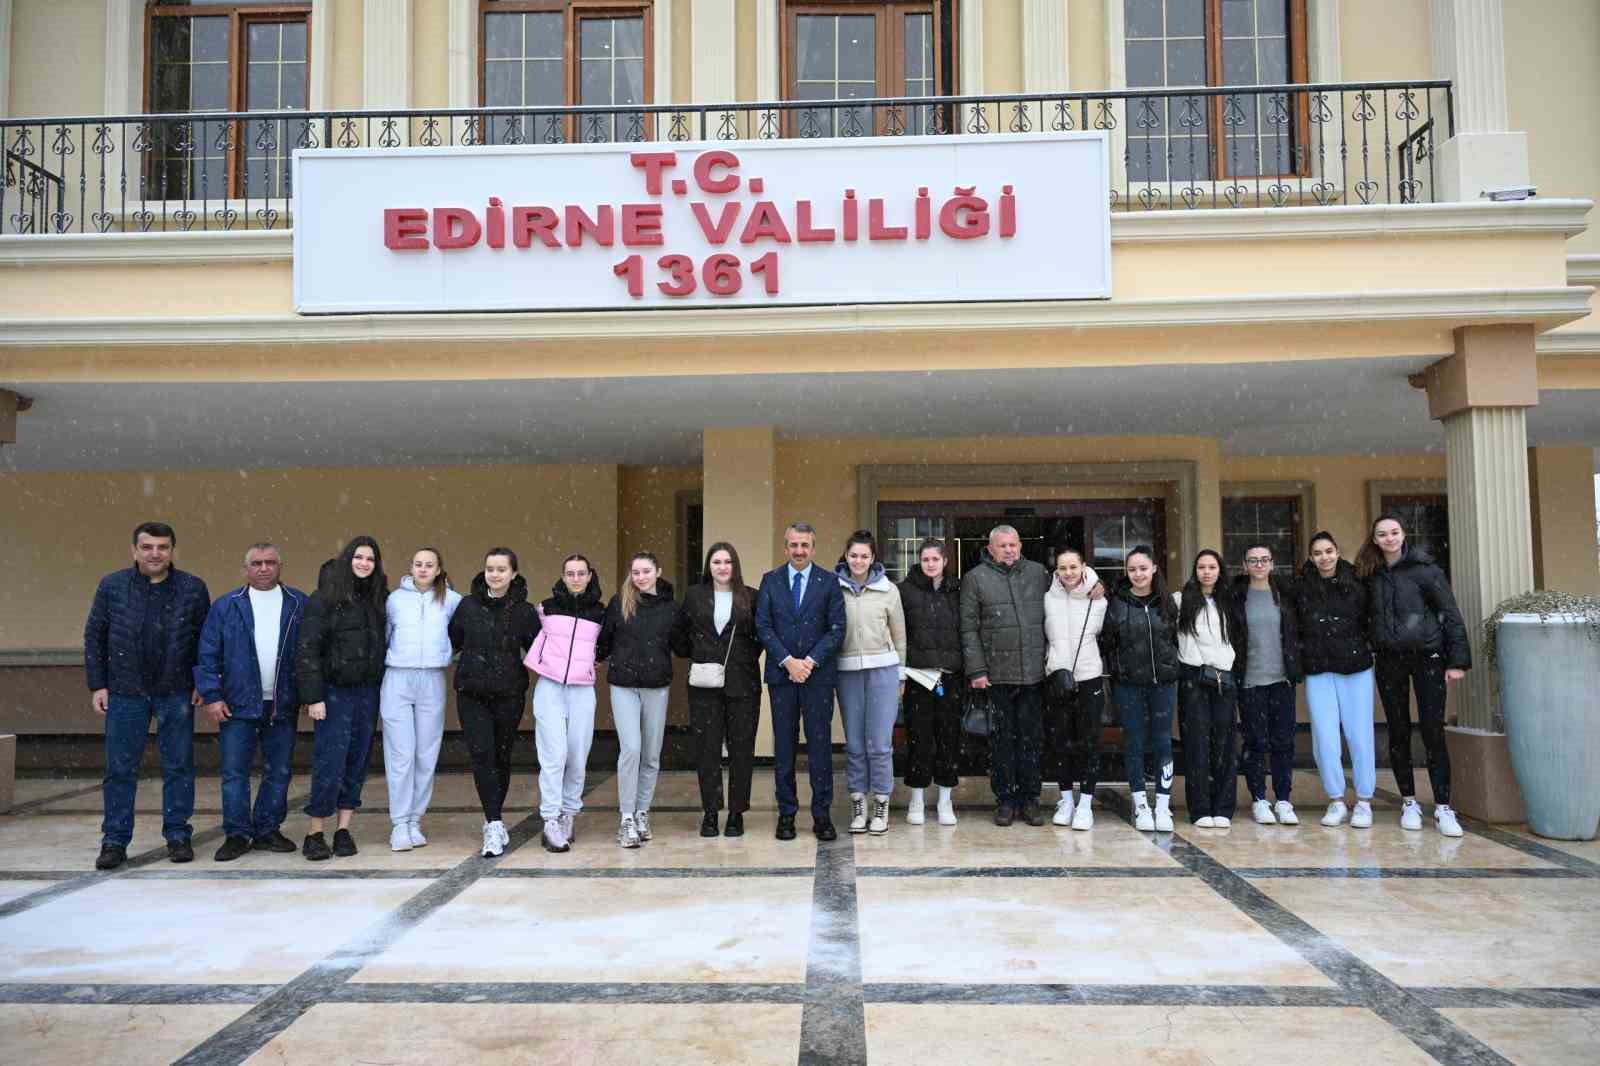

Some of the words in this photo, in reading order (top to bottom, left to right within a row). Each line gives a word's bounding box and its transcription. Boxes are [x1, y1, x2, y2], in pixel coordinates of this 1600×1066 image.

[630, 151, 764, 196] T.C.
[383, 197, 666, 250] EDİRNE
[690, 185, 1017, 246] VALİLİĞİ
[613, 252, 780, 297] 1361
